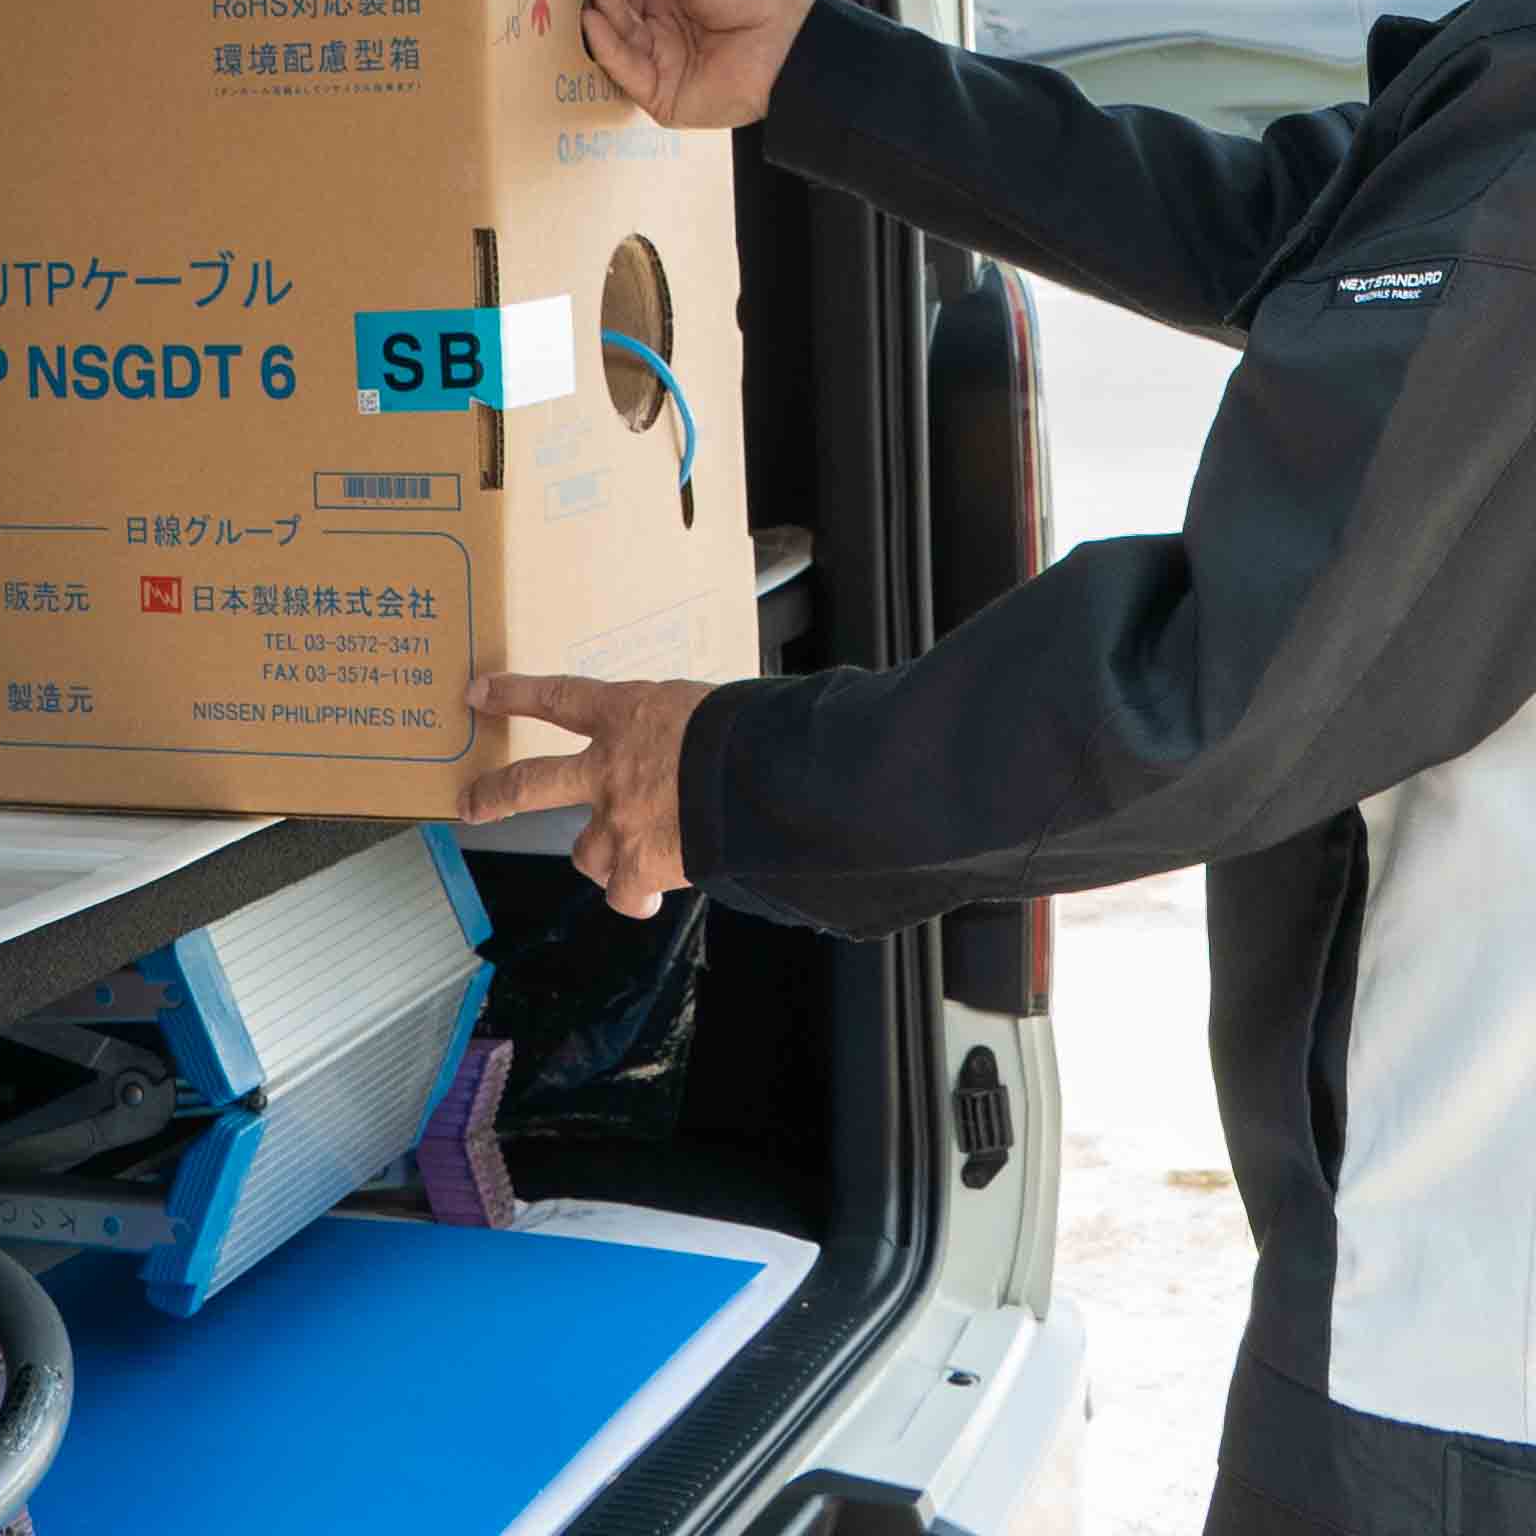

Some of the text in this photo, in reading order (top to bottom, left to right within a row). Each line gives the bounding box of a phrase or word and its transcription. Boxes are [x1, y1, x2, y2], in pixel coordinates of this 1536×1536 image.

[214, 35, 421, 75] 環境配慮型箱
[27, 344, 243, 400] NSGDT
[260, 344, 297, 400] 6
[125, 514, 302, 547] 日線グループ
[3, 581, 91, 612] 販売元
[192, 583, 438, 619] 日本製線株式会社
[264, 633, 432, 656] TEL 03-3572-3471
[263, 663, 434, 686] FAX 03-3574-1198
[7, 682, 94, 713] 製造元
[192, 702, 444, 729] NISSEN PHILIPPINES INC.
